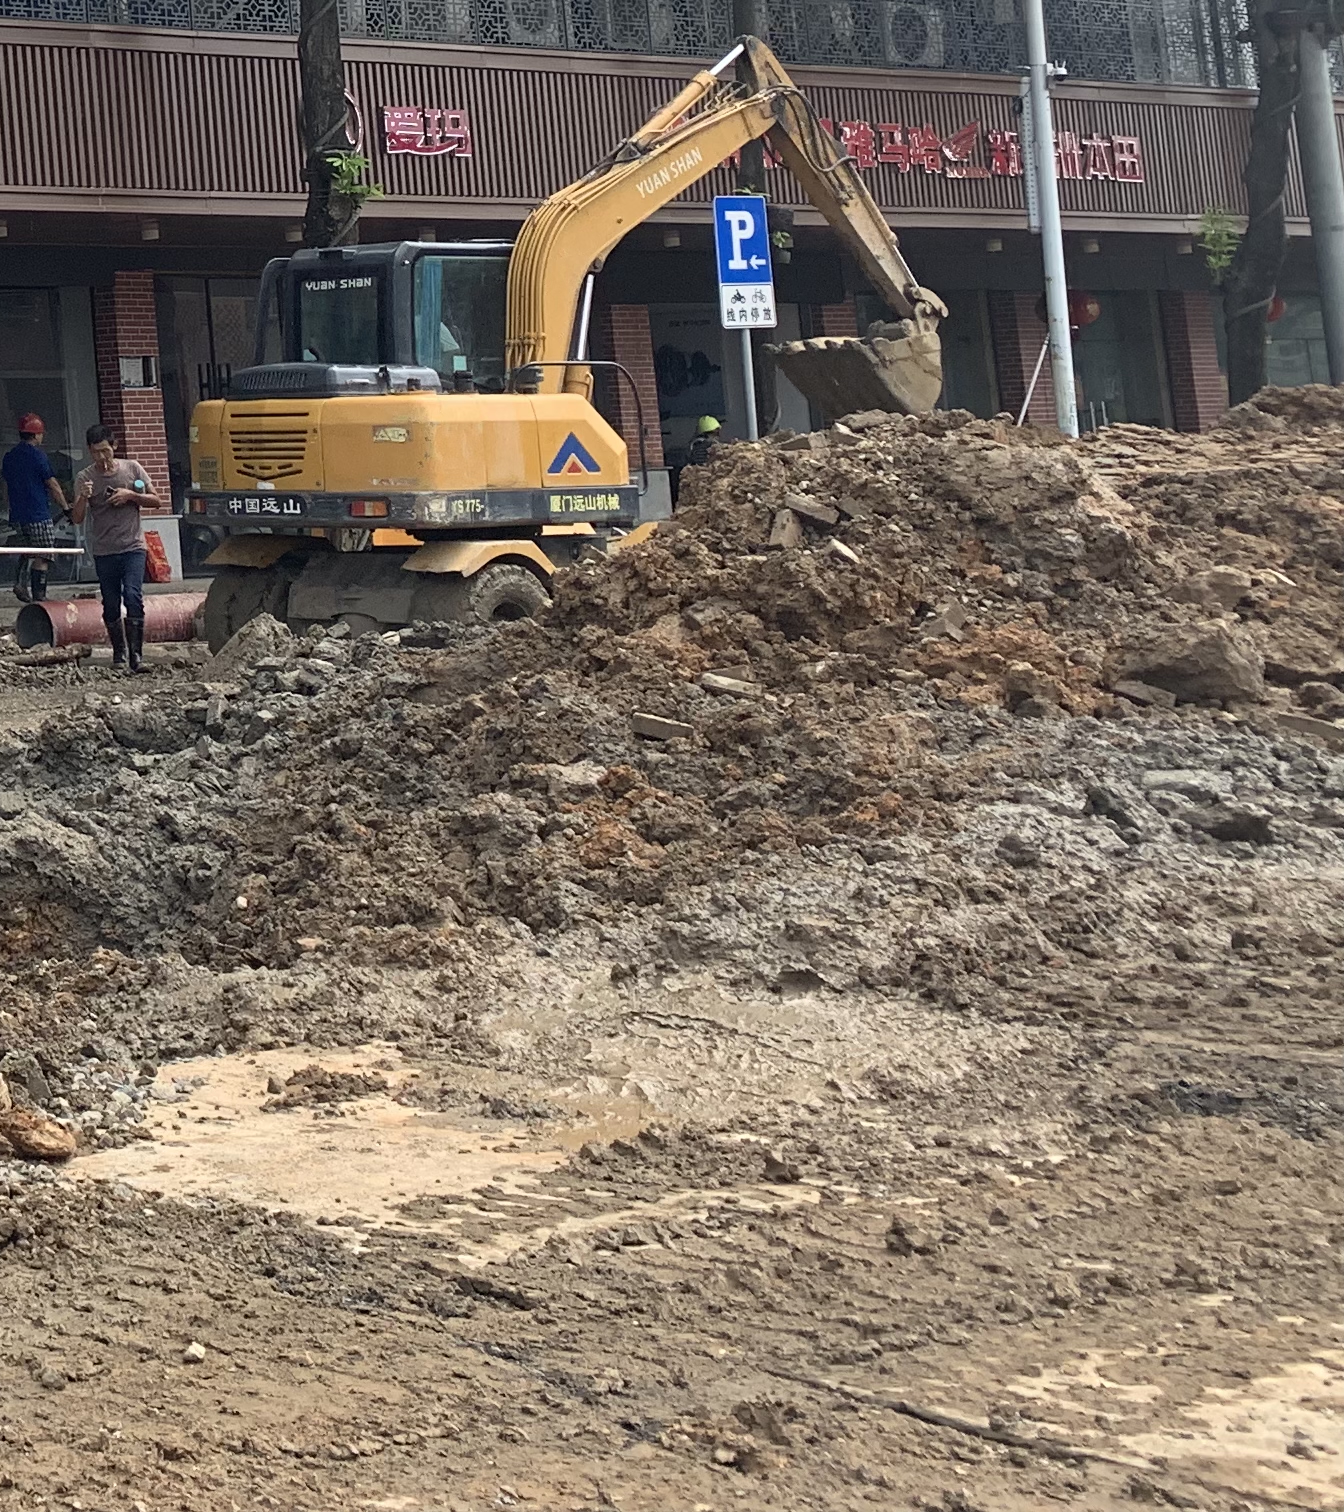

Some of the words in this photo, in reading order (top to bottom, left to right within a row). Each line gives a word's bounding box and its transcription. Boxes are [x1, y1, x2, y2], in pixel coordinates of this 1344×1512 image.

[383, 104, 473, 157] 爱玛
[635, 167, 672, 199] YUAN
[669, 146, 703, 179] SHAN
[724, 210, 755, 270] P
[228, 497, 302, 514] 中国远山
[549, 494, 620, 513] 厦门远山机械
